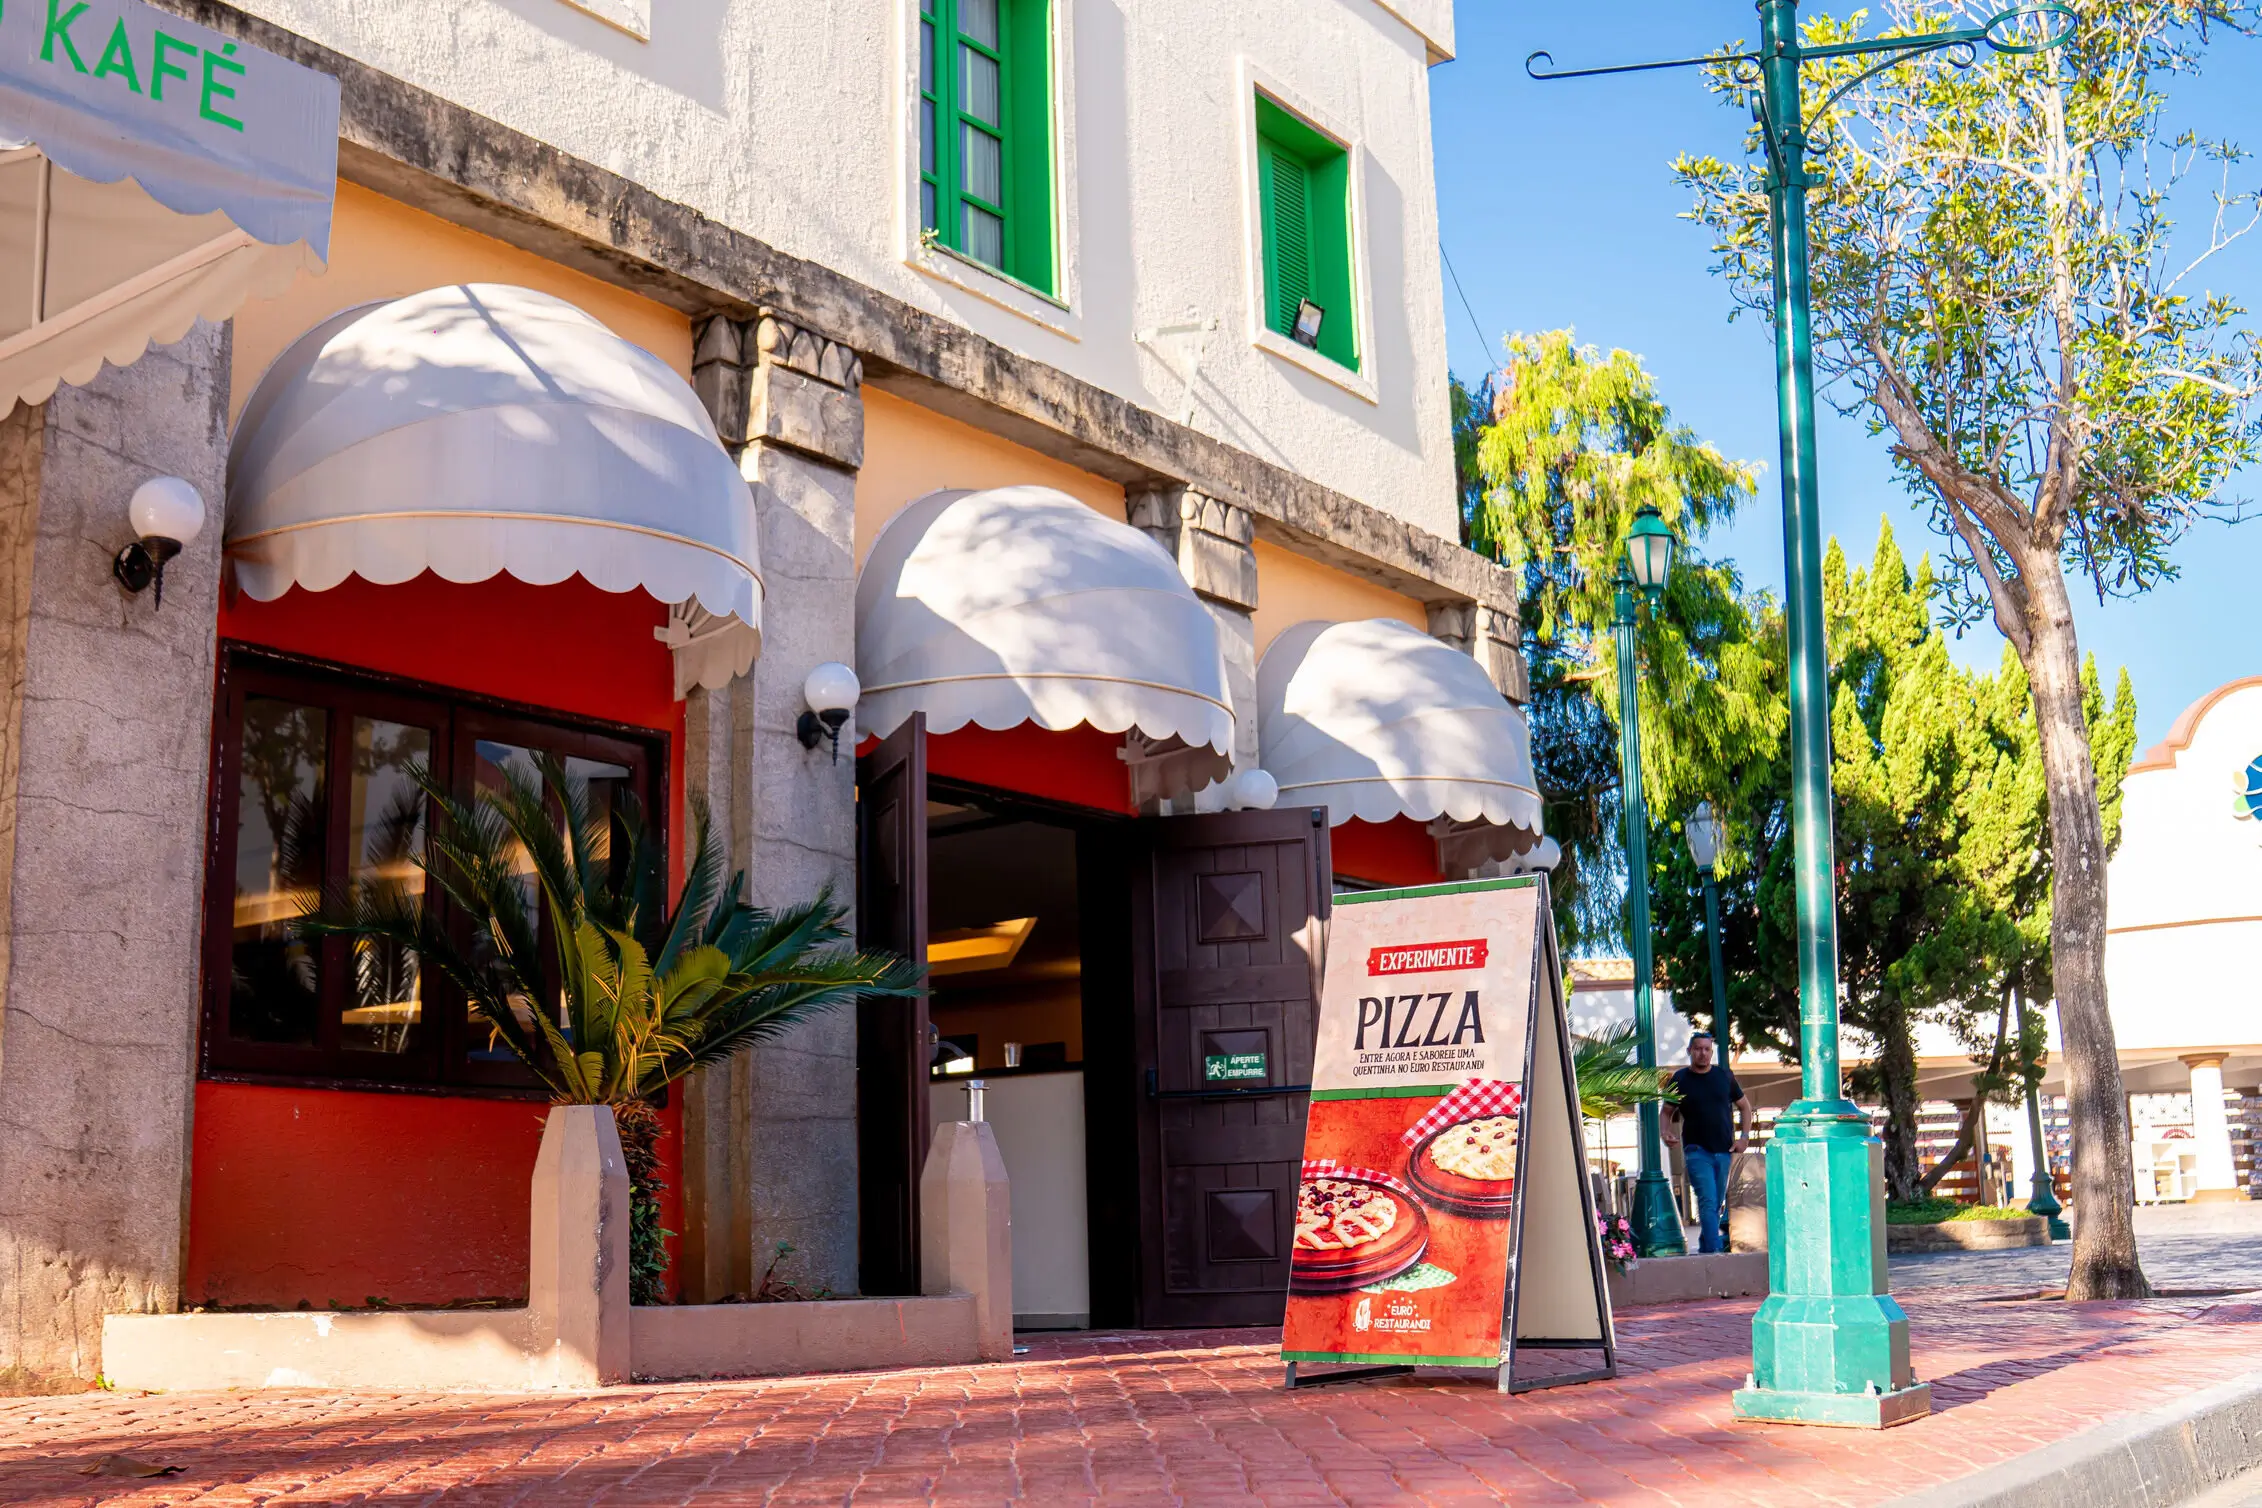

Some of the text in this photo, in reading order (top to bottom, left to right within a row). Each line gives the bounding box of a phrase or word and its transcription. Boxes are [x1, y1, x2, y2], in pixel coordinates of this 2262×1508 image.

[40, 0, 245, 132] KAFÉ
[1379, 946, 1475, 971] EXPERIMENTE
[1353, 990, 1486, 1050] PIZZA
[1230, 1055, 1260, 1064] APERTE
[1360, 1049, 1475, 1063] ENTRE AGORA E SABOREIE UMA
[1352, 1060, 1484, 1076] QUENTINHA NO EURO RESTAURANDI
[1391, 1305, 1413, 1316] EURO
[1374, 1318, 1432, 1330] RESTAURANDI
